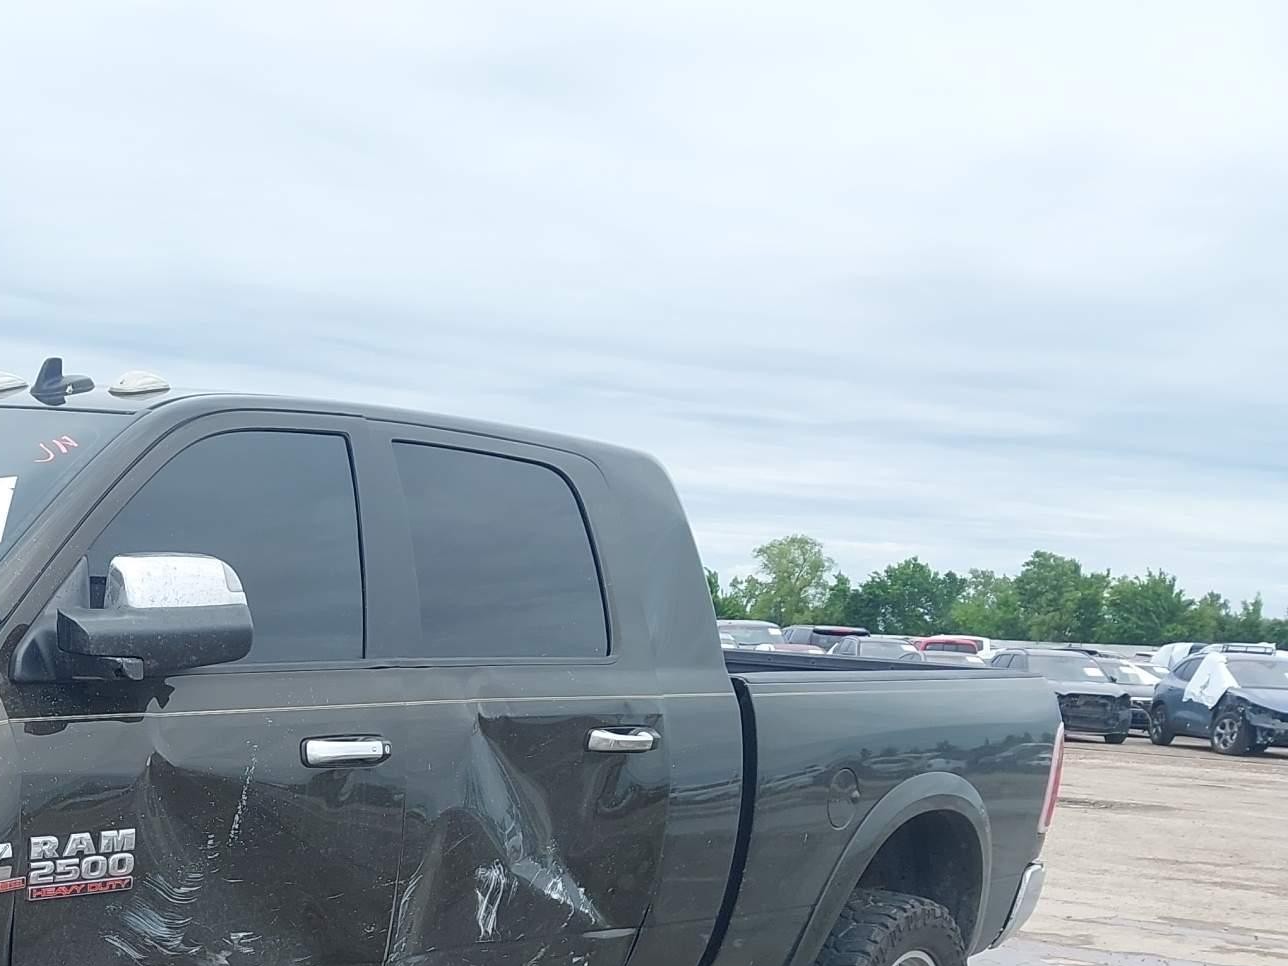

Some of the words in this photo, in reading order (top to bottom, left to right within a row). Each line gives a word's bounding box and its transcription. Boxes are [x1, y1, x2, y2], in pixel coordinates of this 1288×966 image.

[30, 828, 136, 860] RAM
[29, 853, 135, 885] 2500
[33, 883, 85, 897] HEAVY
[87, 880, 129, 893] DUTY
